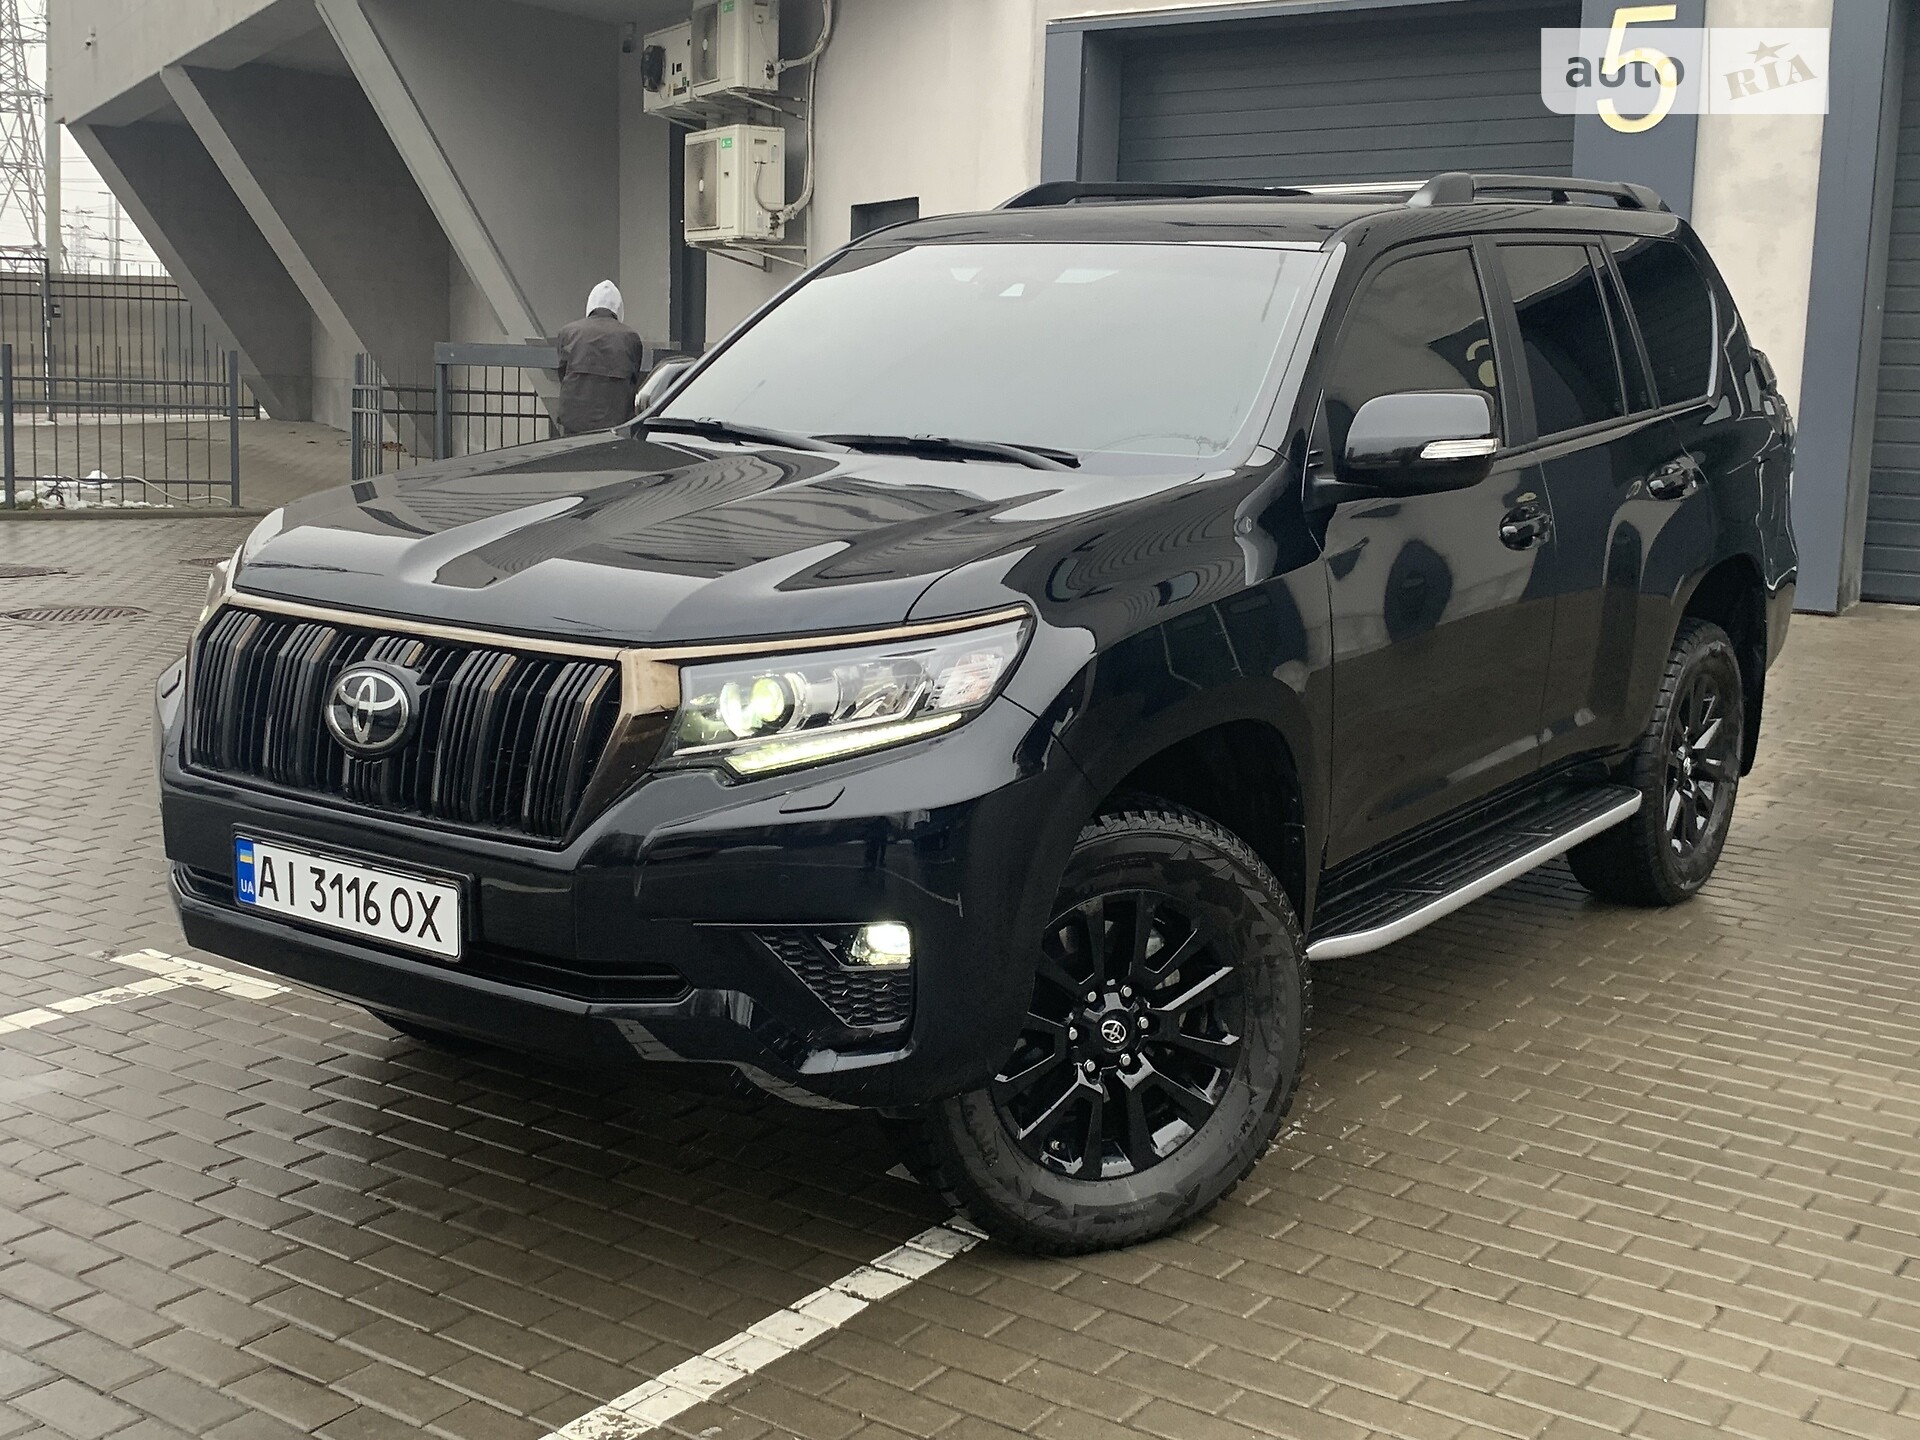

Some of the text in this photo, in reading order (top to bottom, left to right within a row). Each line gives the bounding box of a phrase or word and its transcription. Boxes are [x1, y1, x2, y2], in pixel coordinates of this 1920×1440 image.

[1596, 4, 1677, 134] 5
[240, 878, 255, 895] UA
[258, 855, 442, 943] AI 3116 OX
